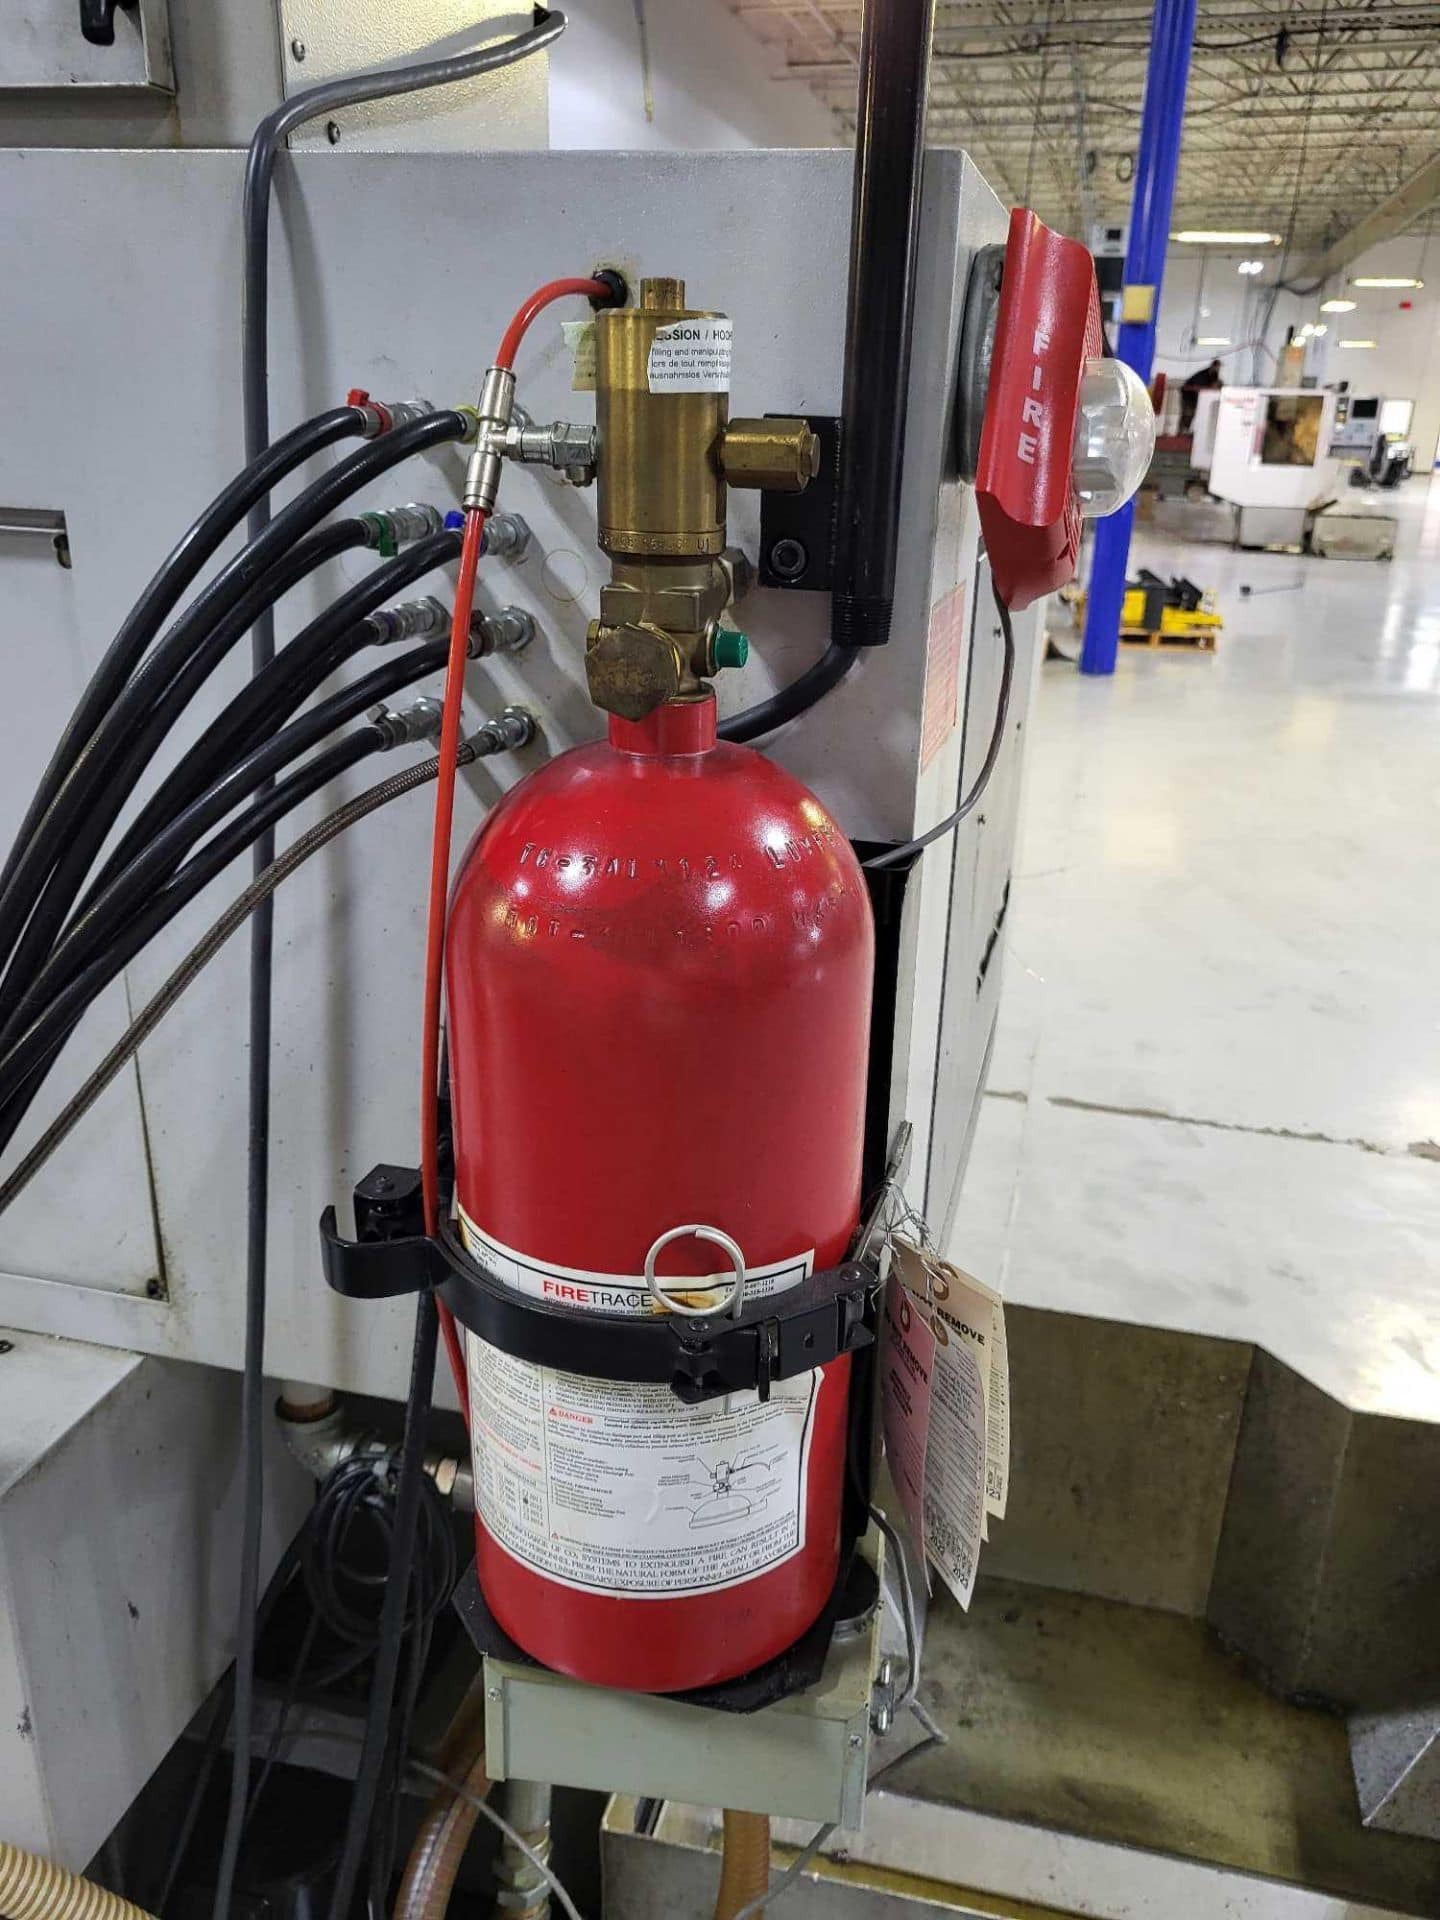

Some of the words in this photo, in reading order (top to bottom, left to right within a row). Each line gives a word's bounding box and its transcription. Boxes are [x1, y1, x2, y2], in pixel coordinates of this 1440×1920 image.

[651, 360, 666, 368] lors
[1017, 328, 1051, 465] FIRE
[936, 1307, 985, 1346] REMOVE
[559, 1410, 594, 1425] DANGER
[615, 1568, 659, 1579] NATURAL
[660, 1568, 687, 1578] FORM
[721, 1554, 748, 1569] AGENT
[625, 1560, 638, 1568] TO
[640, 1558, 694, 1568] EXTINGUISH
[730, 1545, 747, 1557] CAN
[614, 1578, 661, 1587] EXPOSURE
